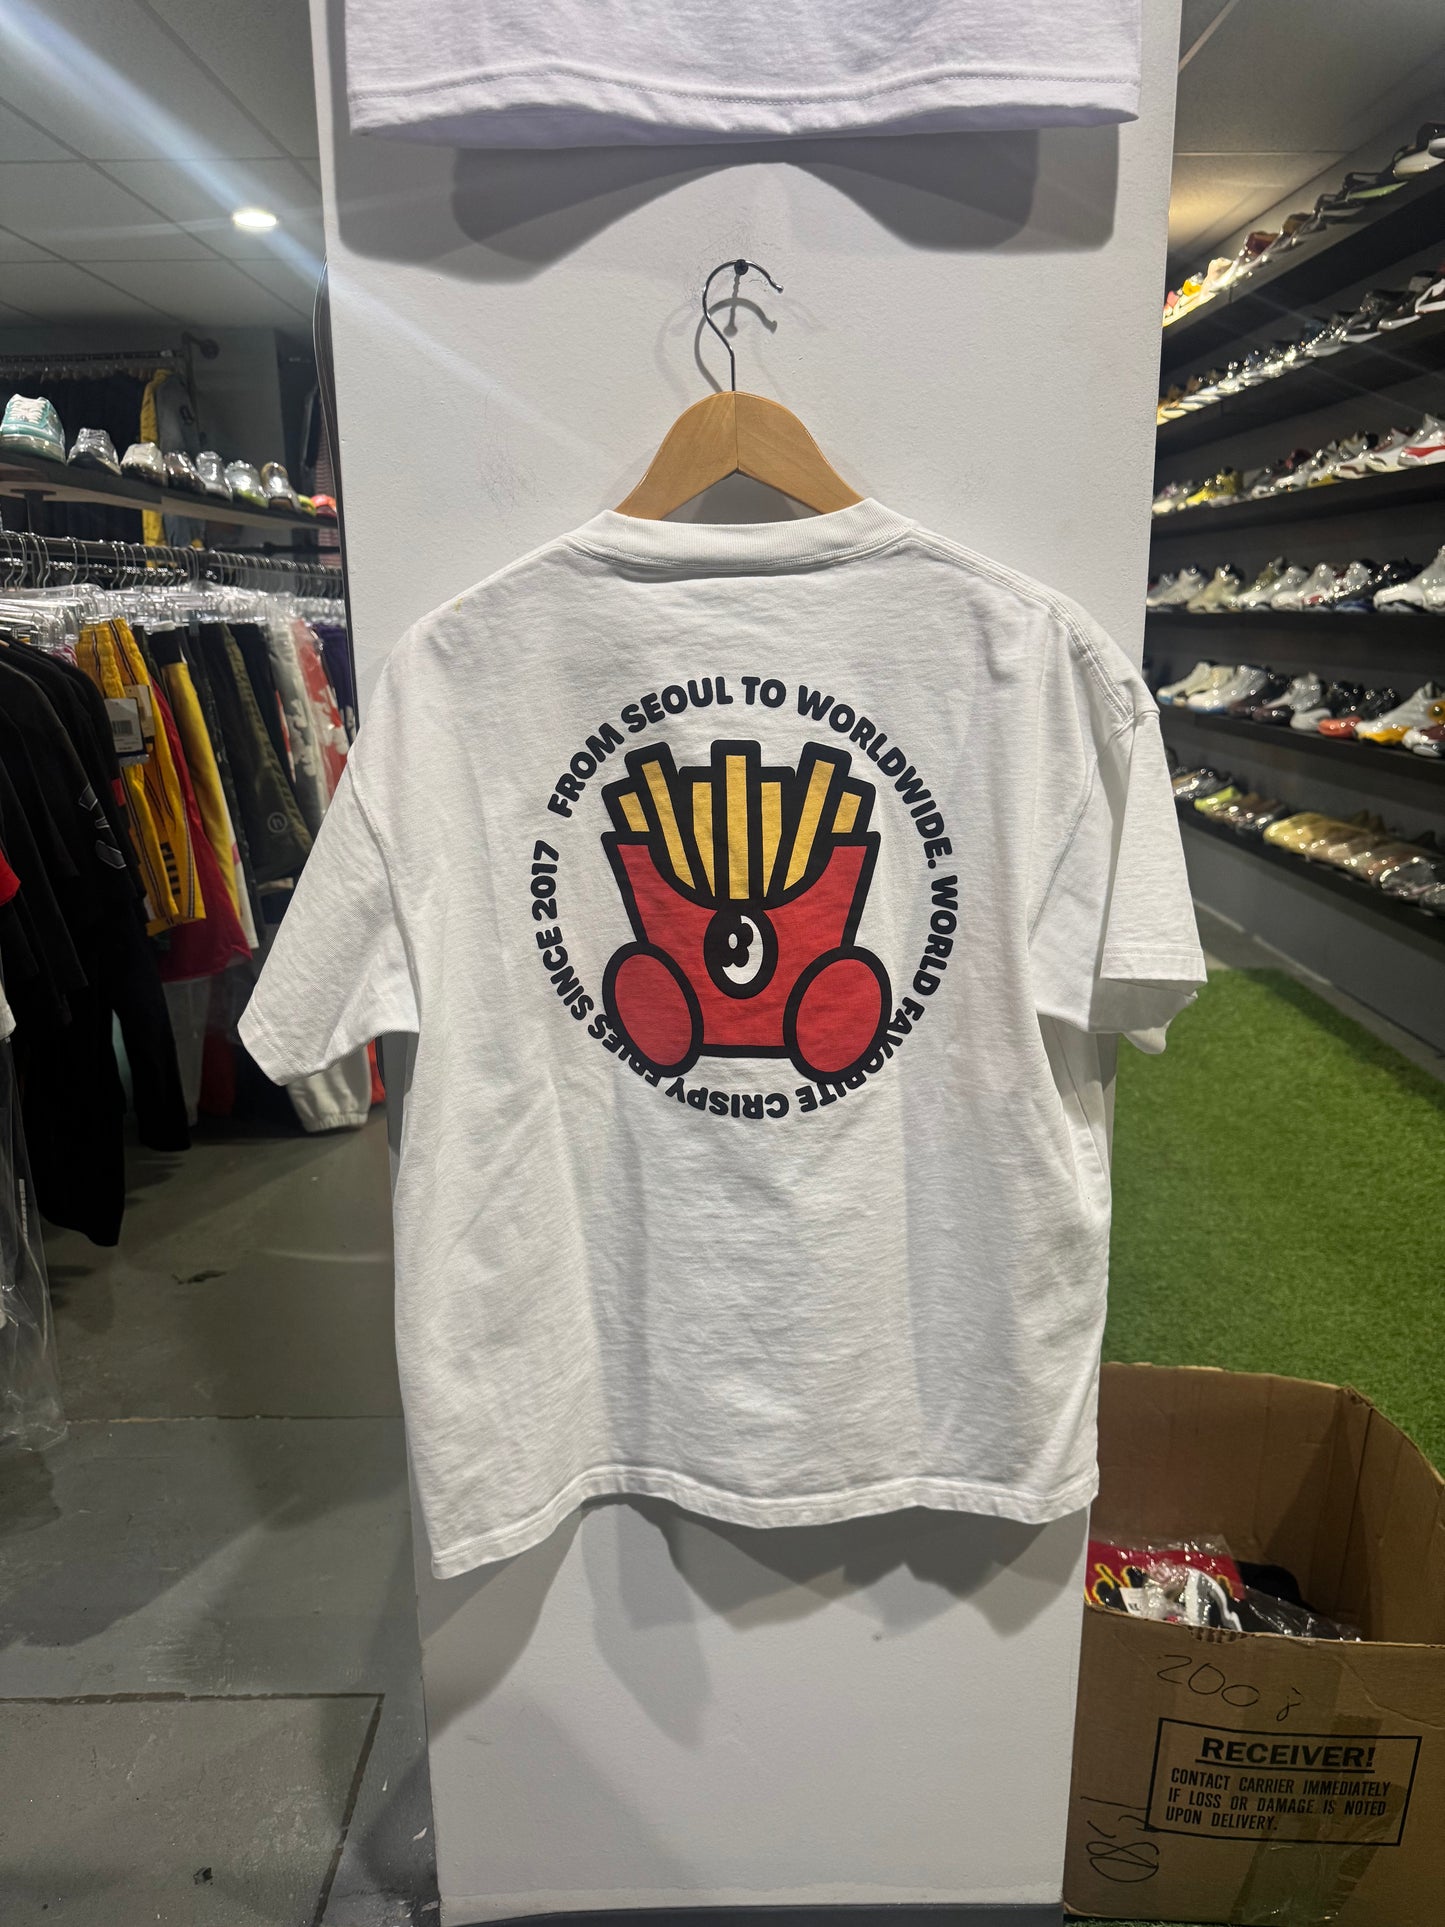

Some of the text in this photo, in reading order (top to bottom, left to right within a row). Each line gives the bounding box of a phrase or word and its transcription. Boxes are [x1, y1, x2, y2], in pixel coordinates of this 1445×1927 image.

[621, 677, 733, 733] SEOUL
[741, 676, 787, 707] TO
[548, 720, 625, 818] FROM
[797, 685, 953, 869] WORLDWIDE.
[531, 840, 560, 921] 2017
[912, 874, 958, 996] WORLD
[536, 926, 595, 1021] SINCE
[665, 1077, 789, 1119] CRISPY
[1201, 1736, 1375, 1768] RECEIVER!
[1168, 1788, 1386, 1817] IF LOSS OR DAMAGE IS NOTED
[1170, 1768, 1390, 1797] CONTACT CARRIER IMMEDIATELY
[1165, 1806, 1278, 1831] UPON DELIVERY.
